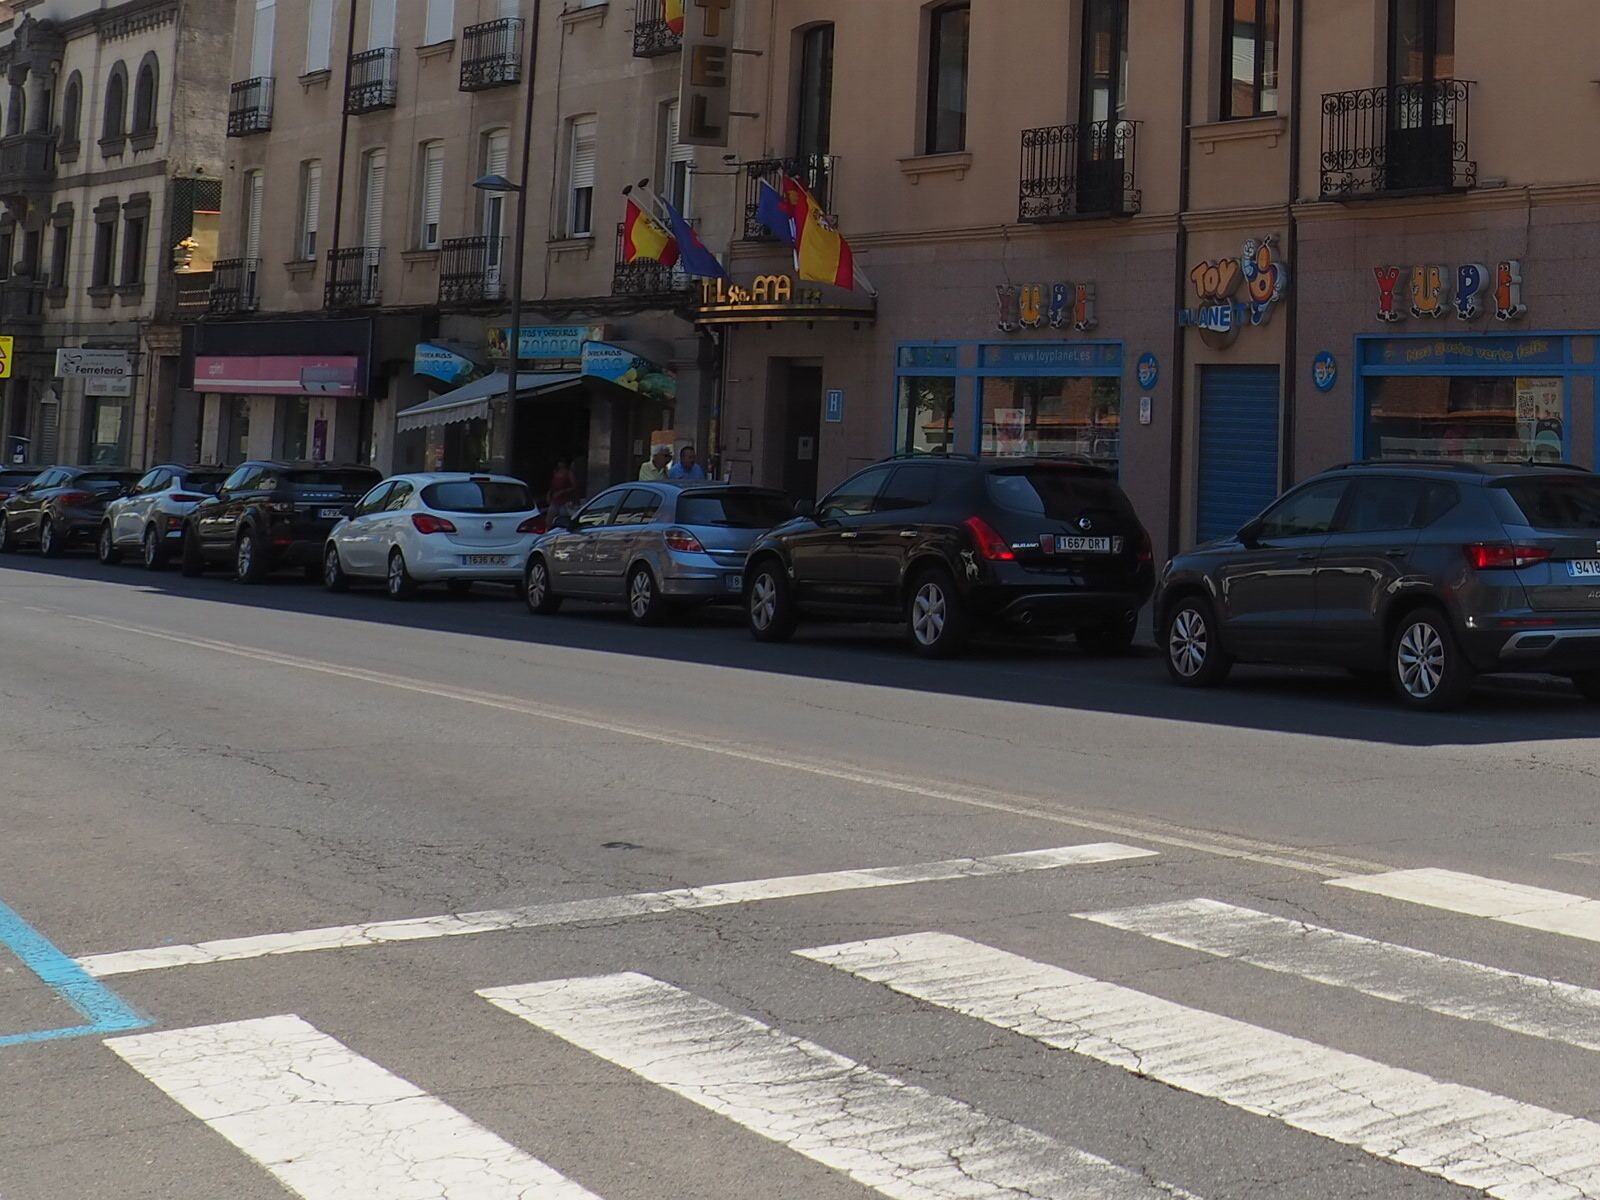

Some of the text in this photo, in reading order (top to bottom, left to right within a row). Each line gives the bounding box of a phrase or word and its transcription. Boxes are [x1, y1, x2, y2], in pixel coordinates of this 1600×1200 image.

[752, 274, 792, 303] ANA
[1191, 259, 1239, 301] TOY
[1372, 260, 1524, 322] YUPI
[994, 282, 1098, 332] YUPI
[1178, 303, 1248, 331] PLANET
[1013, 349, 1091, 364] www.toyplanet.es
[1475, 346, 1514, 362] verte
[75, 365, 124, 375] Ferretería
[830, 393, 838, 412] H
[1063, 537, 1106, 550] 1667 DRT
